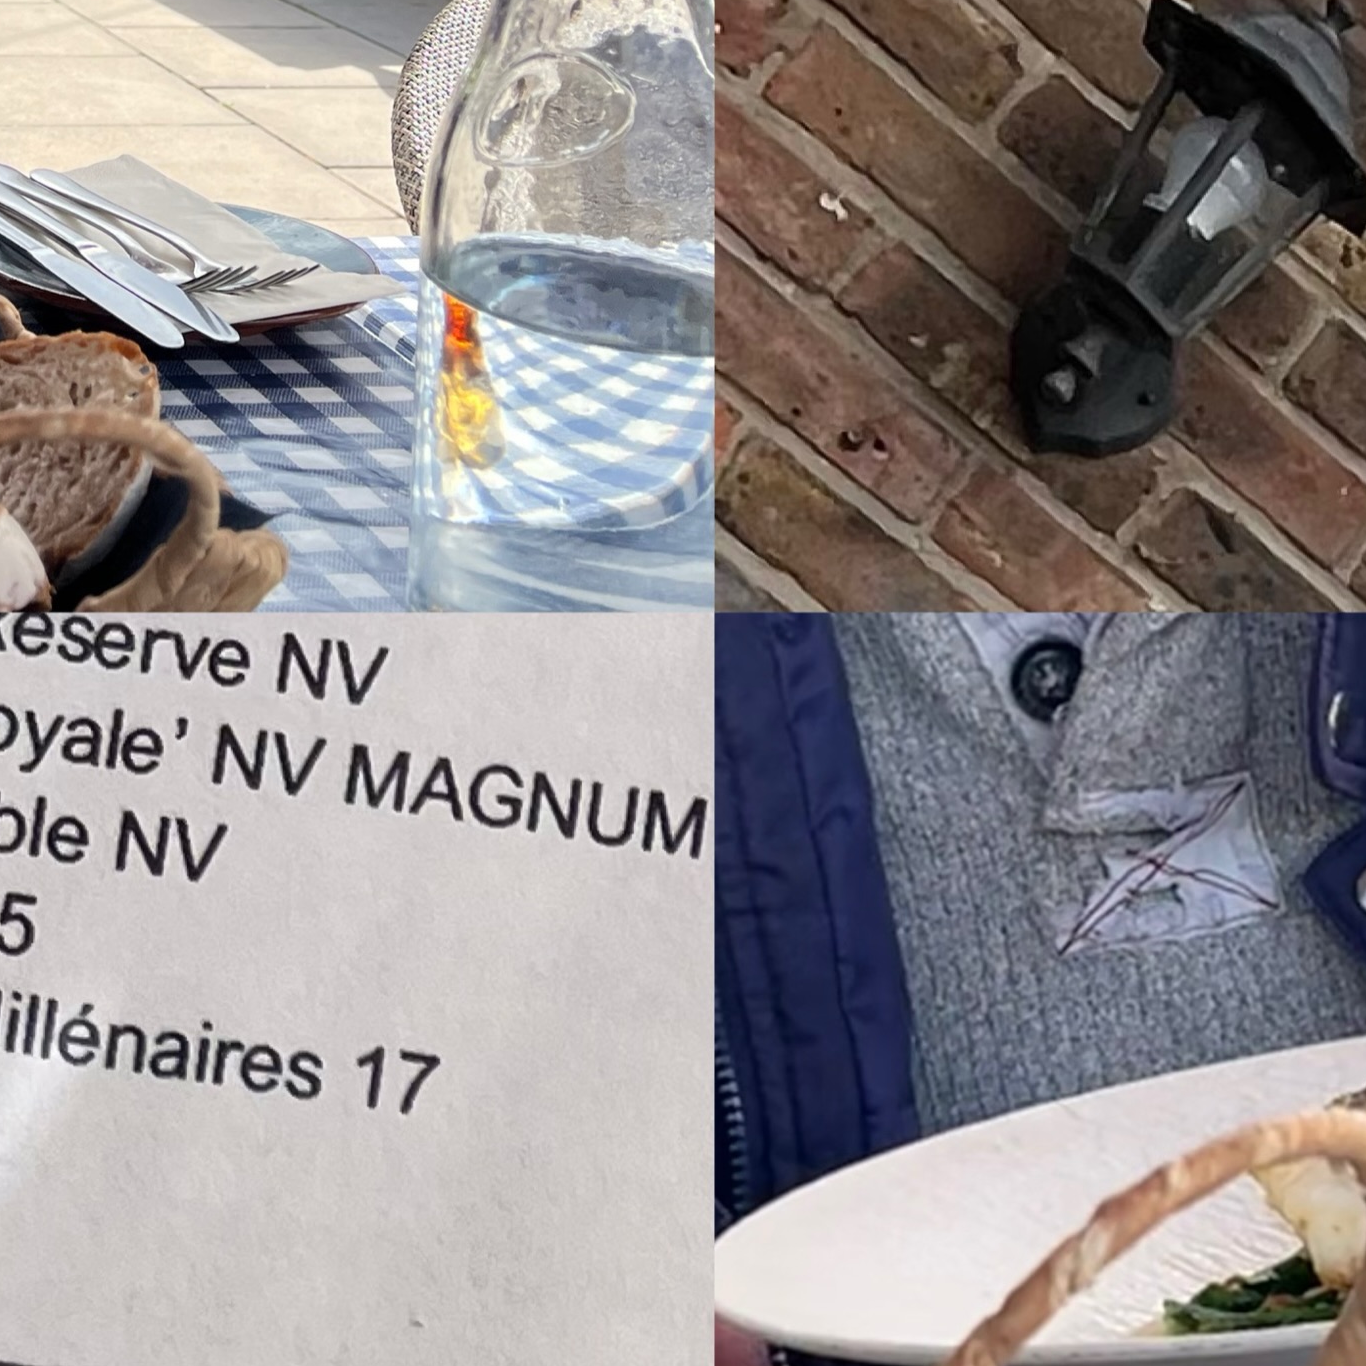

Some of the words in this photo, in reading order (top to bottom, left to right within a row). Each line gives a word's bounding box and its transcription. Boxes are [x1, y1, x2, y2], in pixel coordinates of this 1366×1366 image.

[277, 632, 389, 705] NV
[212, 723, 327, 796] NV
[344, 743, 708, 859] MAGNUM
[115, 809, 228, 882] NV
[357, 1046, 440, 1115] 17
